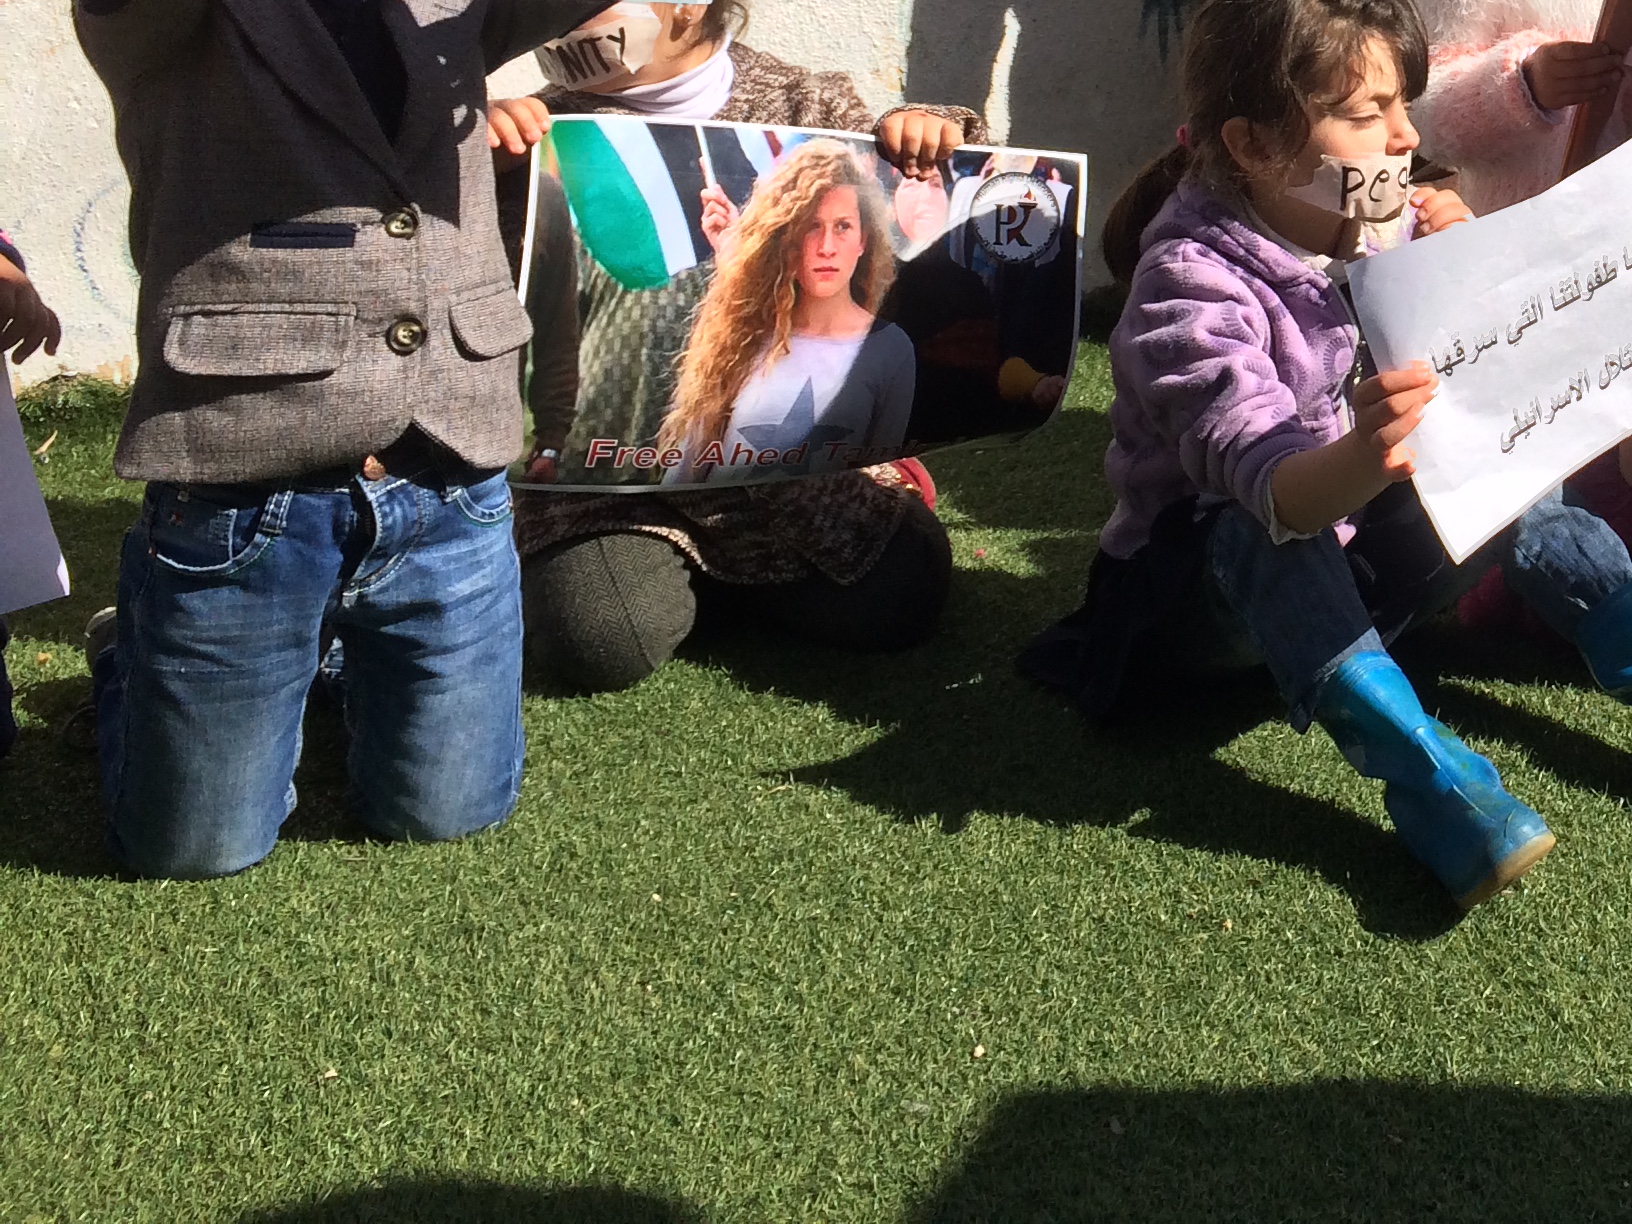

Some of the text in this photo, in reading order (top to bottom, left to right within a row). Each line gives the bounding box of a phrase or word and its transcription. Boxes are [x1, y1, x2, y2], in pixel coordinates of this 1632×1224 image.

[1549, 255, 1619, 312] طفولتنا
[1507, 294, 1544, 347] التي
[1429, 327, 1498, 377] سرقها
[585, 438, 683, 469] Free
[693, 441, 813, 468] Ahed
